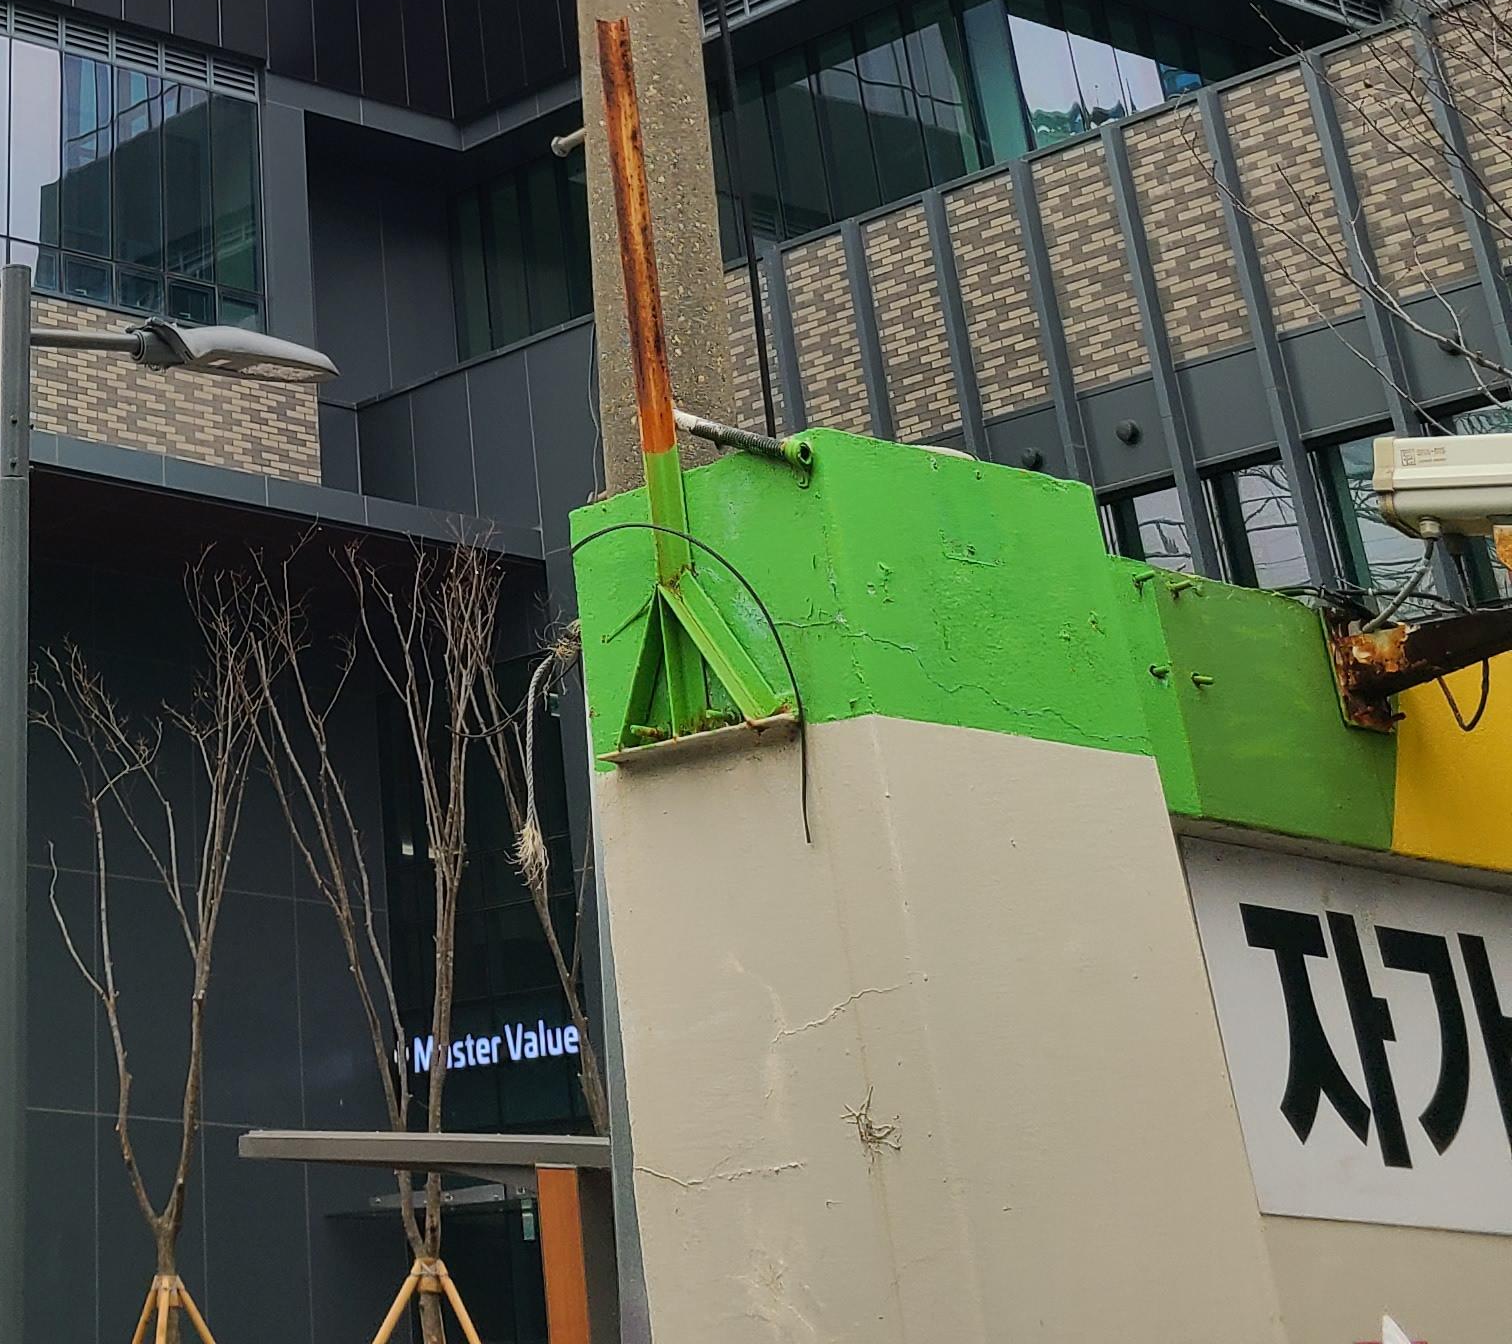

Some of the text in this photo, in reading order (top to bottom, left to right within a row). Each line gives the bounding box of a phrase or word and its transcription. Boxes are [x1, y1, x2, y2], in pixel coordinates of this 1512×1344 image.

[414, 1019, 580, 1073] Mster Value
[1239, 902, 1512, 1170] 자가
